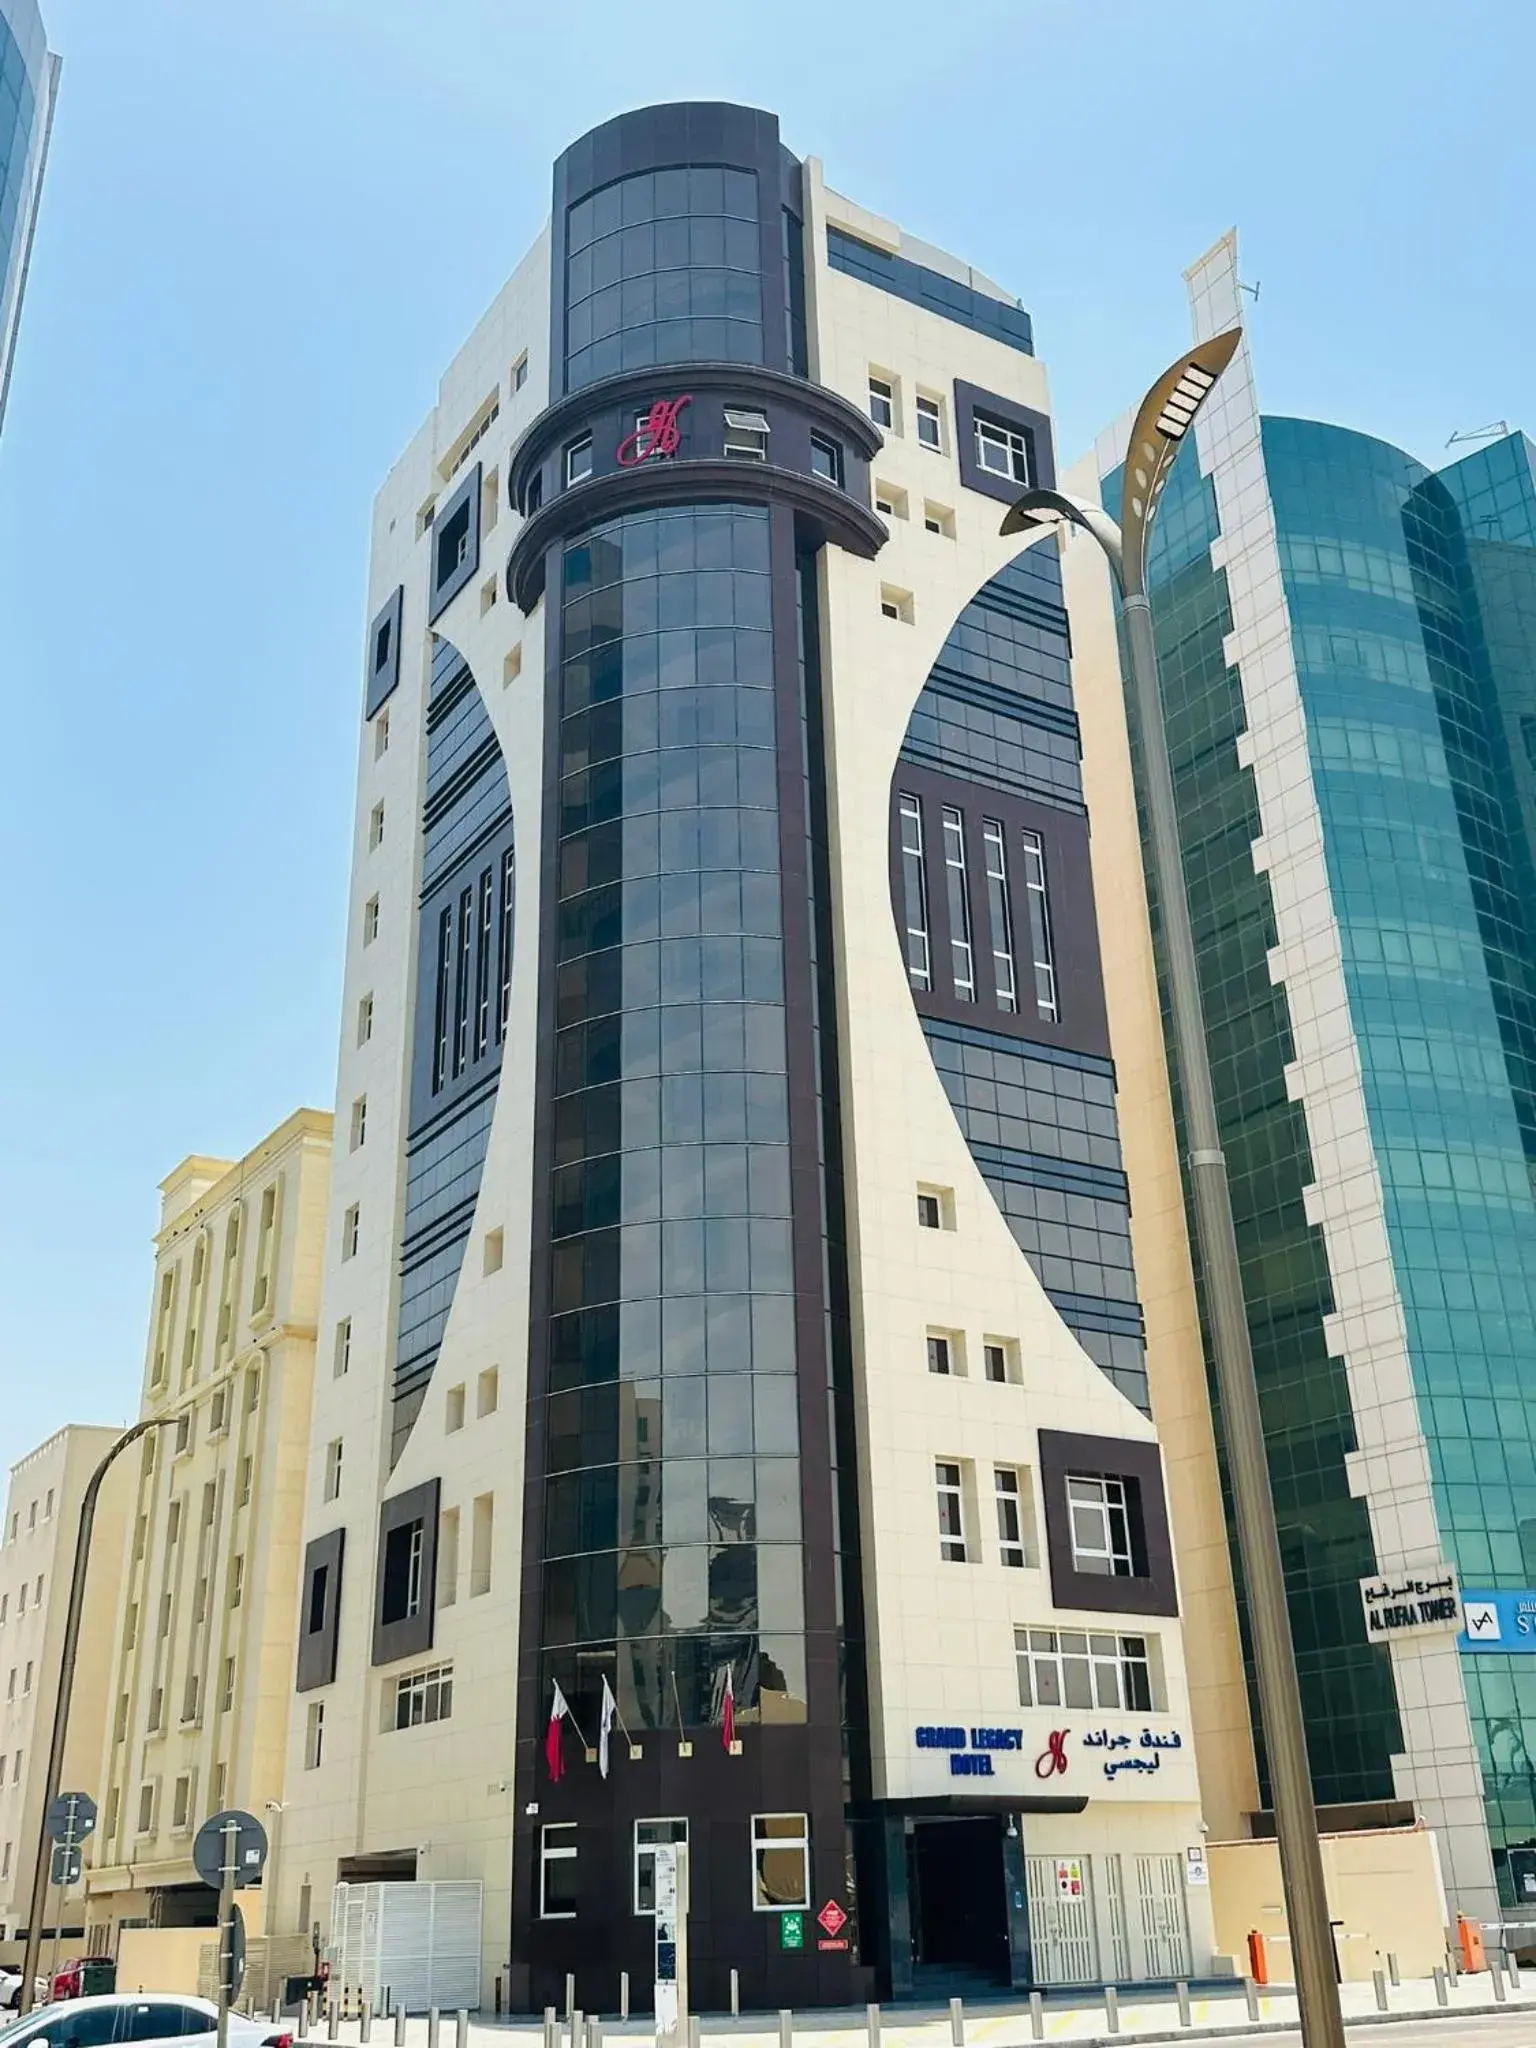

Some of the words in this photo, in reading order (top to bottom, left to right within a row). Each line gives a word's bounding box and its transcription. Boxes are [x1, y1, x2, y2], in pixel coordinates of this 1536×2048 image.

[1370, 1609, 1384, 1631] AL
[1417, 1597, 1458, 1623] TOWER
[915, 1726, 966, 1749] GRAND
[970, 1727, 1023, 1750] LEGACY
[1083, 1728, 1131, 1750] جراند
[1140, 1727, 1182, 1748] فندق
[950, 1753, 995, 1776] HOTEL
[1104, 1752, 1160, 1780] ليجسي
